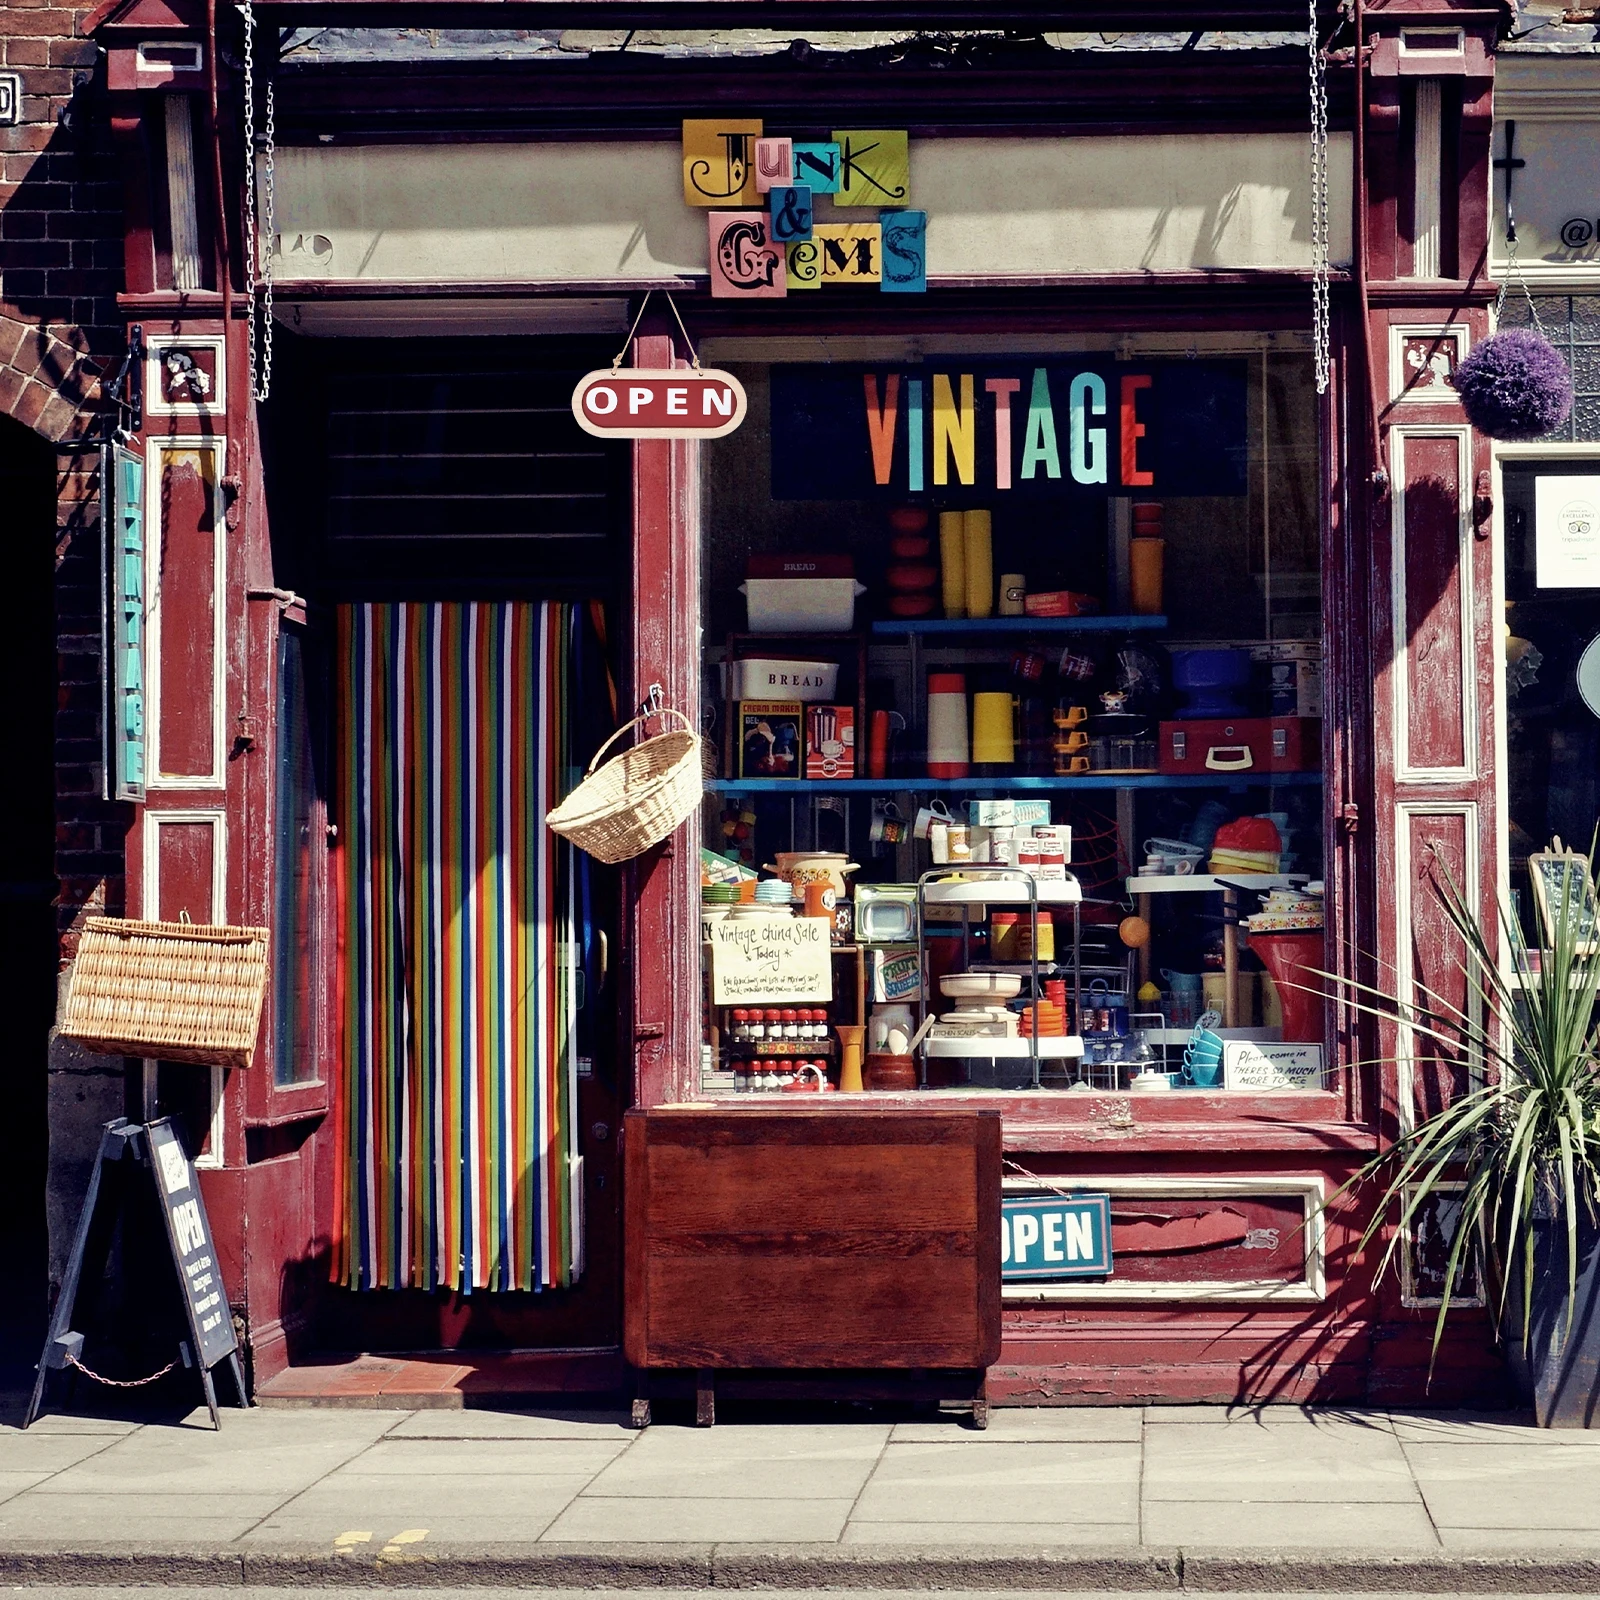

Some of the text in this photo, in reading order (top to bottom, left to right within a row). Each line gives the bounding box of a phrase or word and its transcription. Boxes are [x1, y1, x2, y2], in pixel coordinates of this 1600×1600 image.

[775, 188, 810, 238] &
[586, 387, 732, 416] OPEN
[863, 368, 1154, 491] VINTAGE
[784, 563, 816, 571] BREAD
[768, 673, 824, 687] BREAD
[743, 704, 800, 713] CREAM MAKER
[718, 925, 757, 954] Vintage
[794, 923, 819, 945] Sale
[752, 945, 780, 971] Today
[880, 956, 918, 981] FRUIT
[1296, 1050, 1307, 1058] in
[1284, 1067, 1317, 1075] MUCH
[172, 1198, 206, 1256] OPEN
